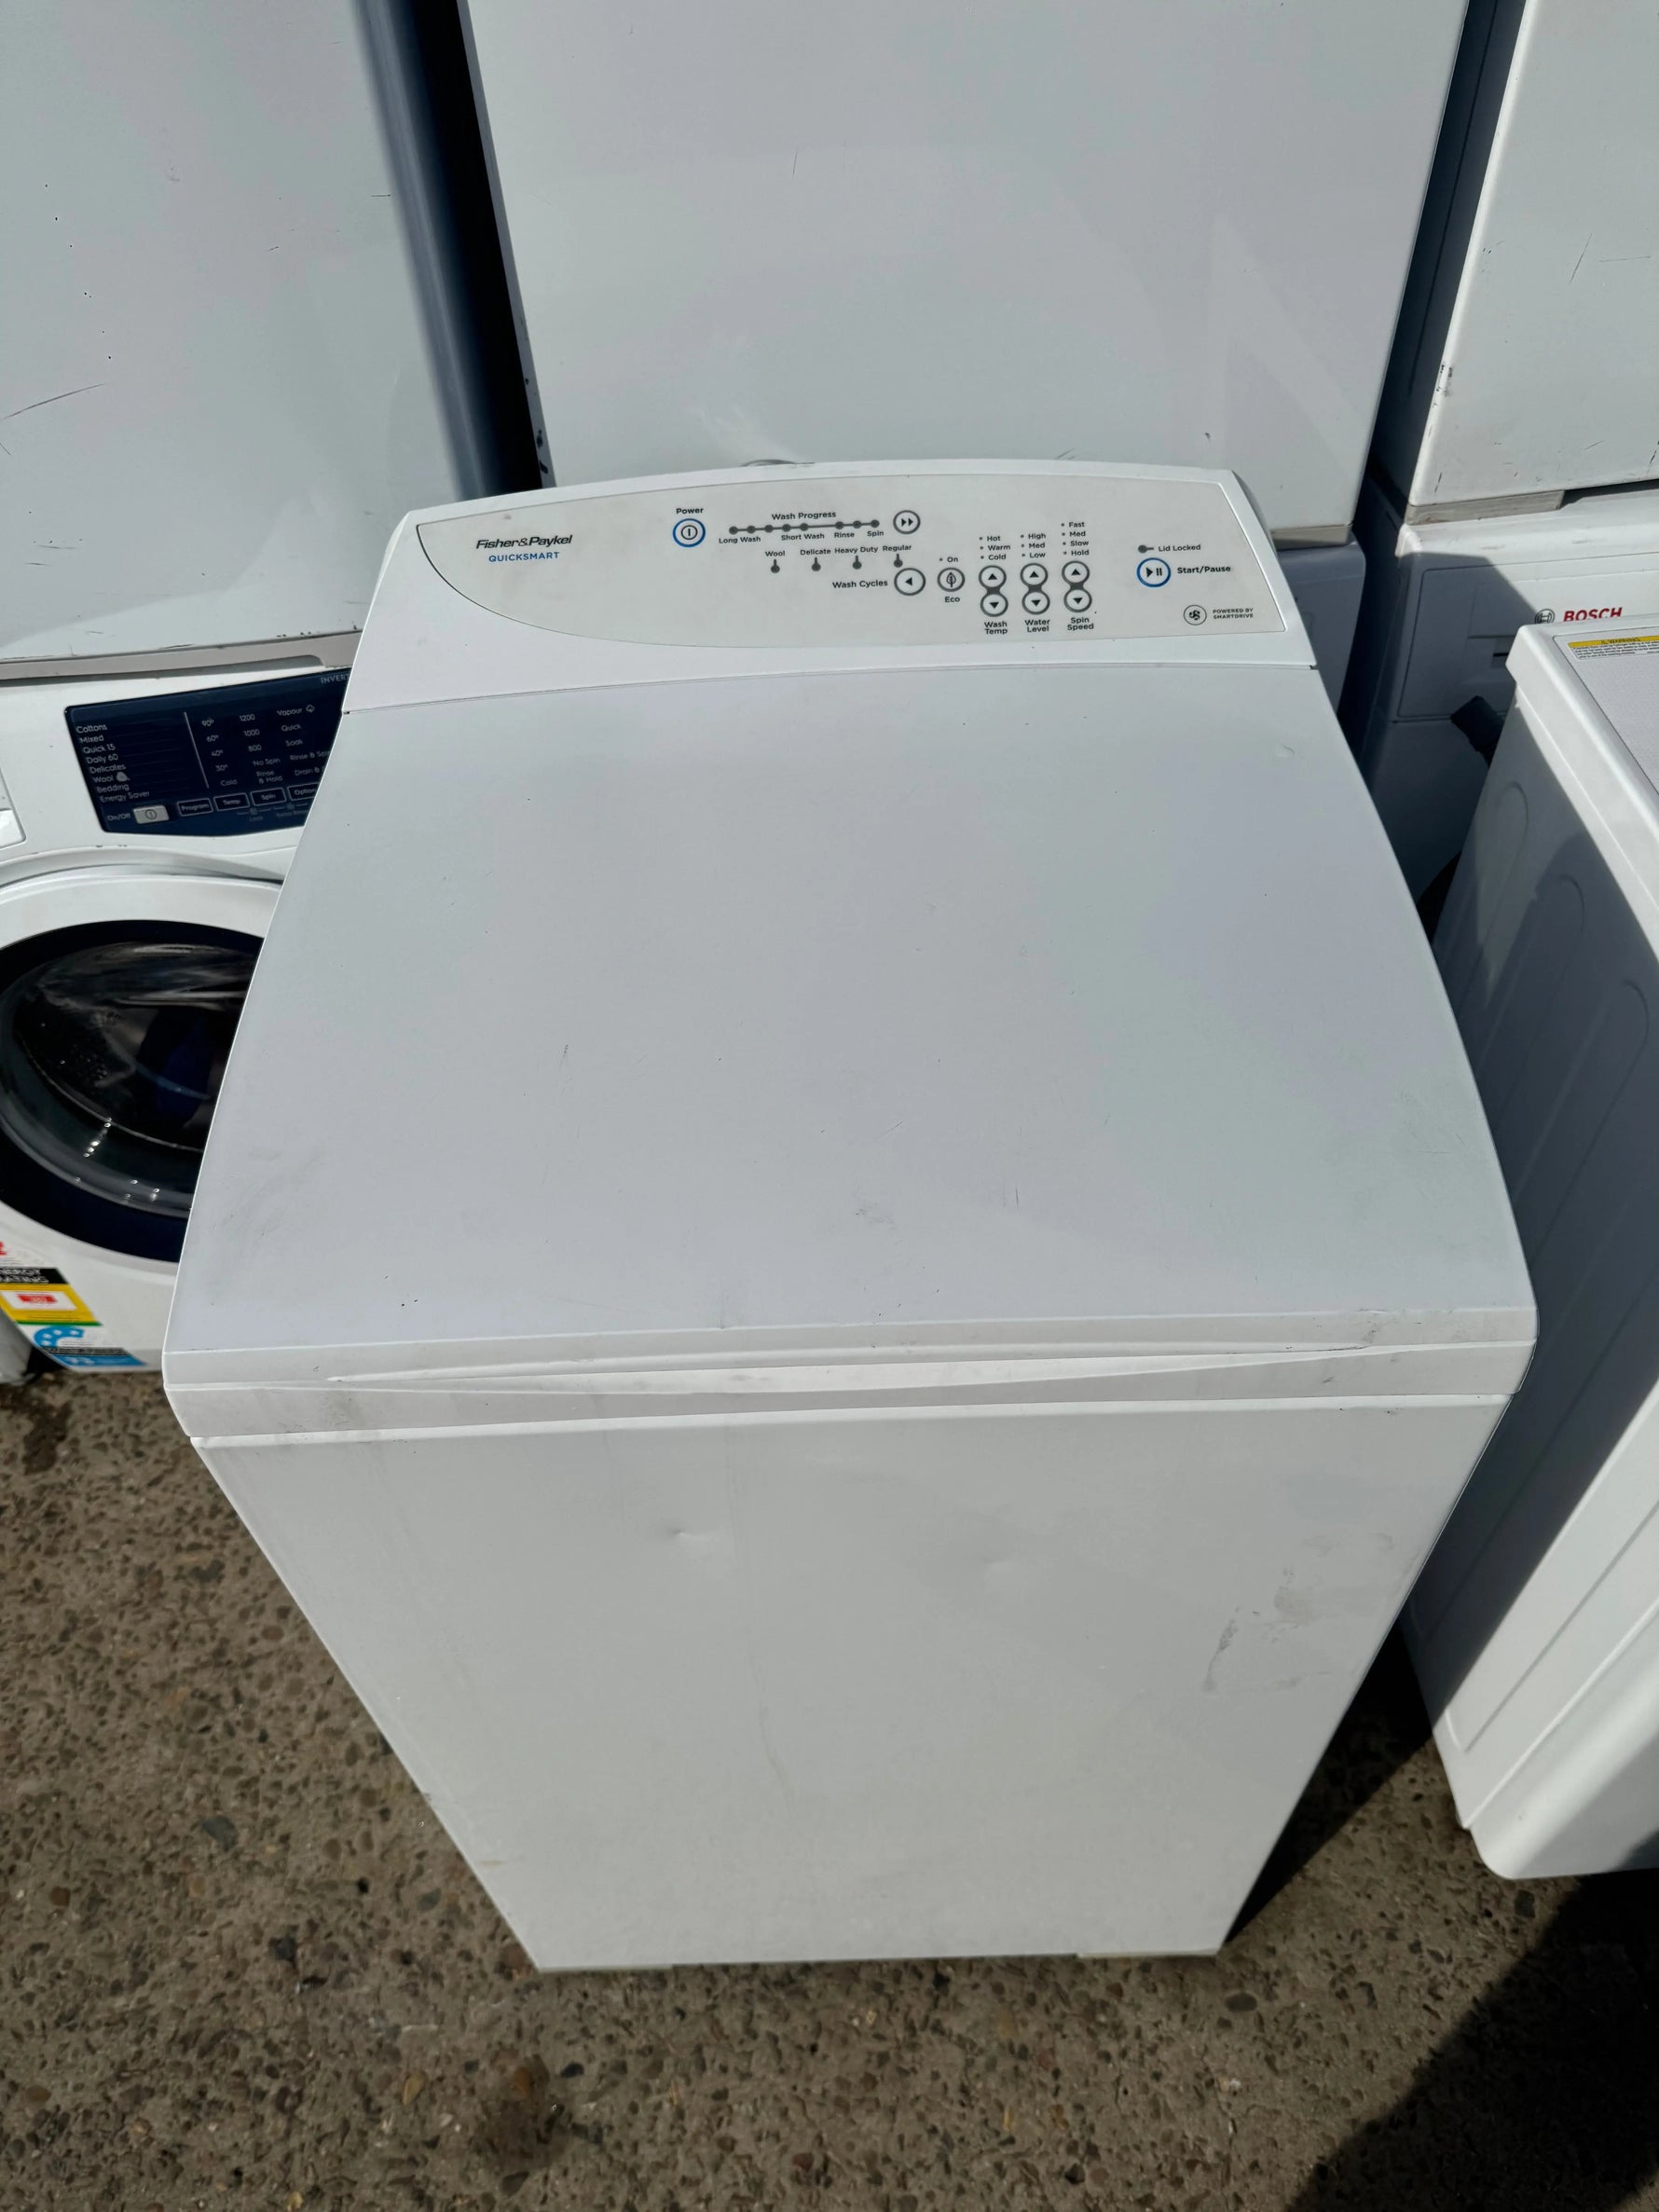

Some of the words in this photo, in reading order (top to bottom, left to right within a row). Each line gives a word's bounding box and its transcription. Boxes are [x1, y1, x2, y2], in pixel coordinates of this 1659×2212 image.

[798, 511, 836, 520] Progress
[867, 529, 884, 538] Spin
[476, 535, 572, 549] Fisher&Paykel
[719, 537, 737, 545] Long
[834, 546, 857, 555] Heavy
[859, 545, 878, 554] Duty
[488, 552, 560, 562] QUICKSMART
[1177, 566, 1231, 574] Start/Pause
[832, 581, 857, 589] Wash
[858, 579, 888, 588] Cycles
[1563, 607, 1623, 622] BOSCH
[1067, 623, 1094, 631] Speed
[277, 708, 303, 717] Vapour
[75, 724, 108, 734] Cottons
[281, 723, 302, 732] Quick
[80, 735, 104, 743] Mixed
[83, 746, 106, 754] Quick
[107, 743, 116, 751] 15
[86, 756, 106, 764] Daily
[265, 758, 281, 766] Spin
[89, 764, 126, 774] Delicates
[93, 775, 114, 783] Wool
[96, 784, 130, 793] Bedding
[100, 793, 126, 803] Energy
[128, 790, 149, 799] Saver
